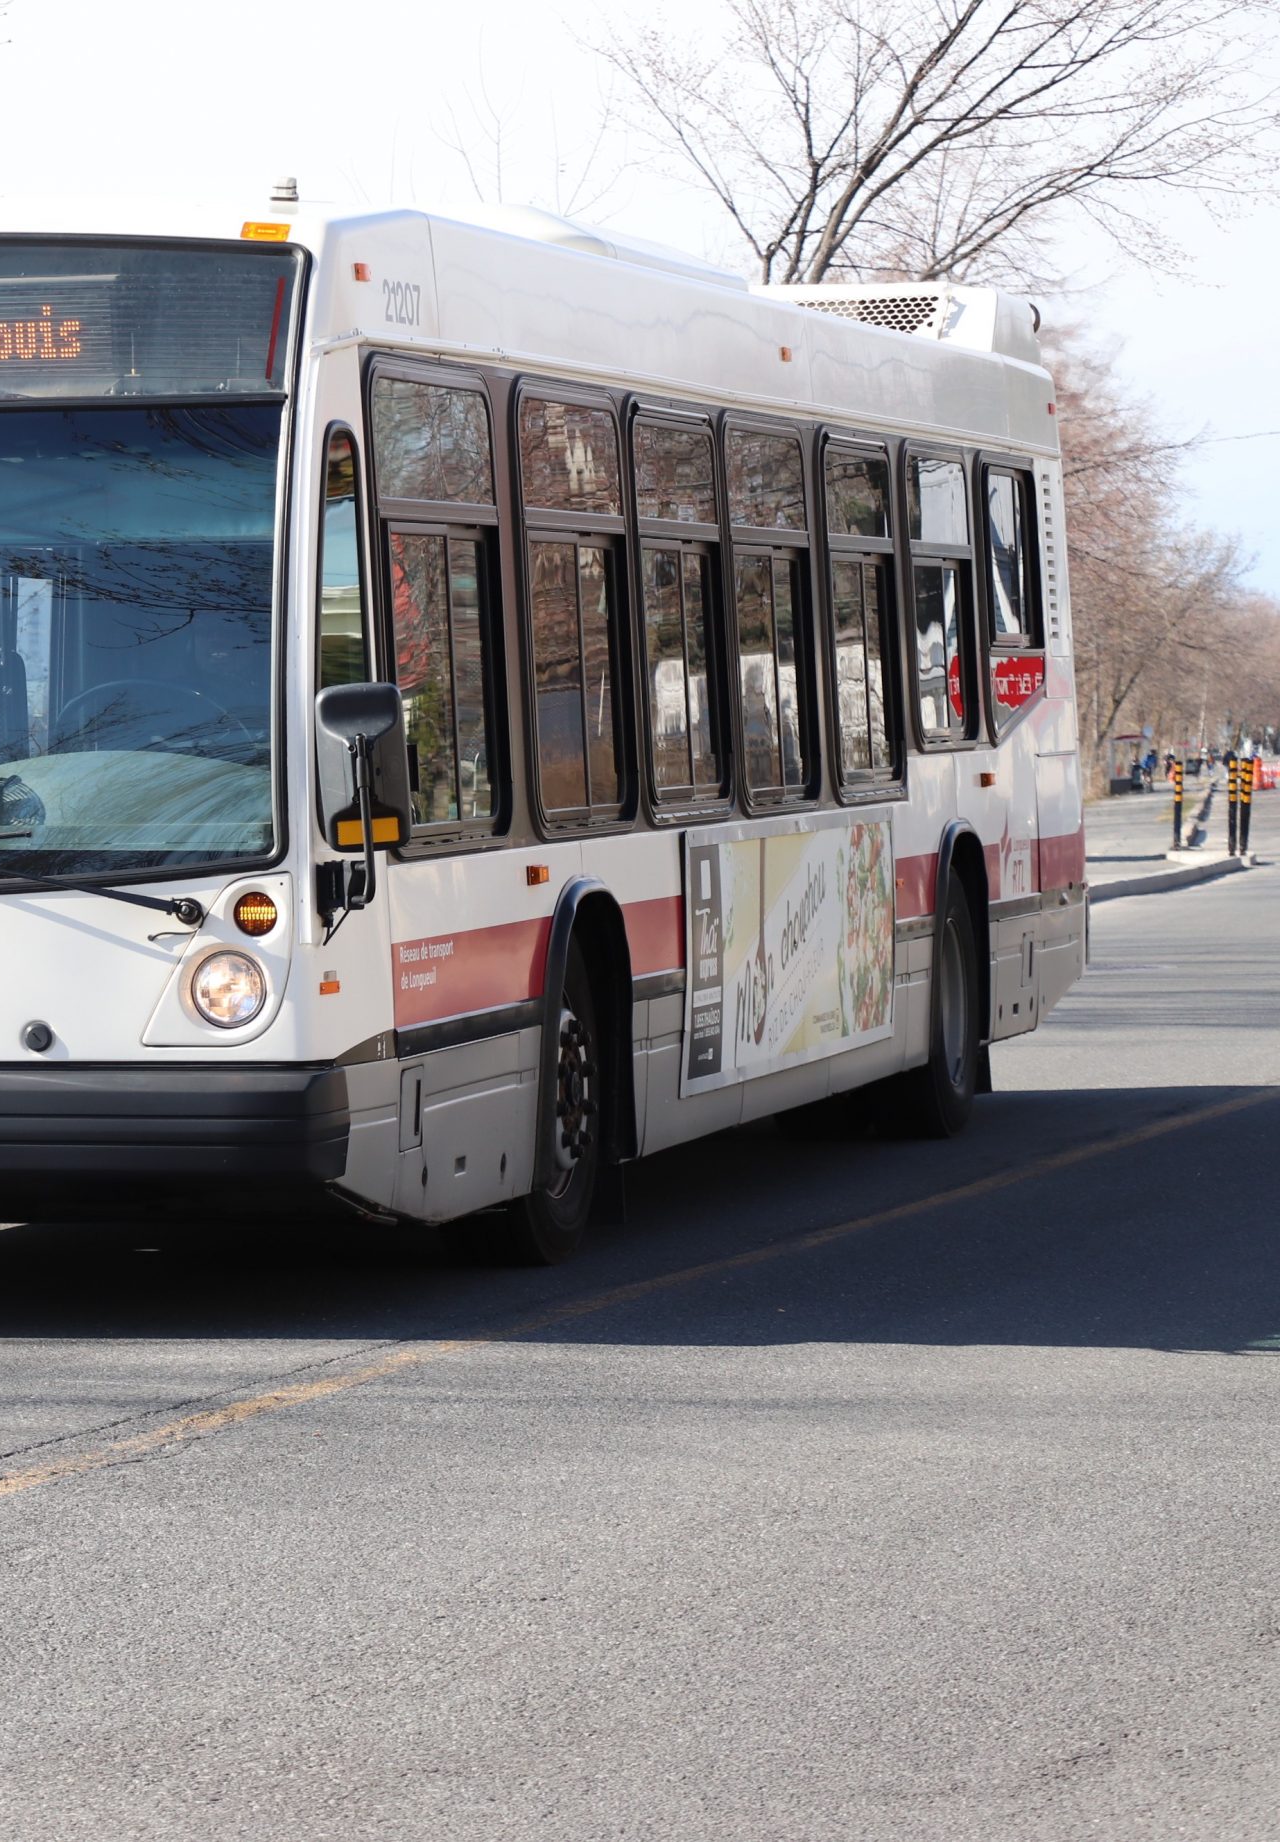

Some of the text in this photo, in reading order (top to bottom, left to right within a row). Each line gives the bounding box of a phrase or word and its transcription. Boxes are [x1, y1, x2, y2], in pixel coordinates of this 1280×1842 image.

[383, 278, 421, 326] 21207
[400, 940, 453, 963] Réseau de transport
[401, 966, 437, 990] de Longueuil
